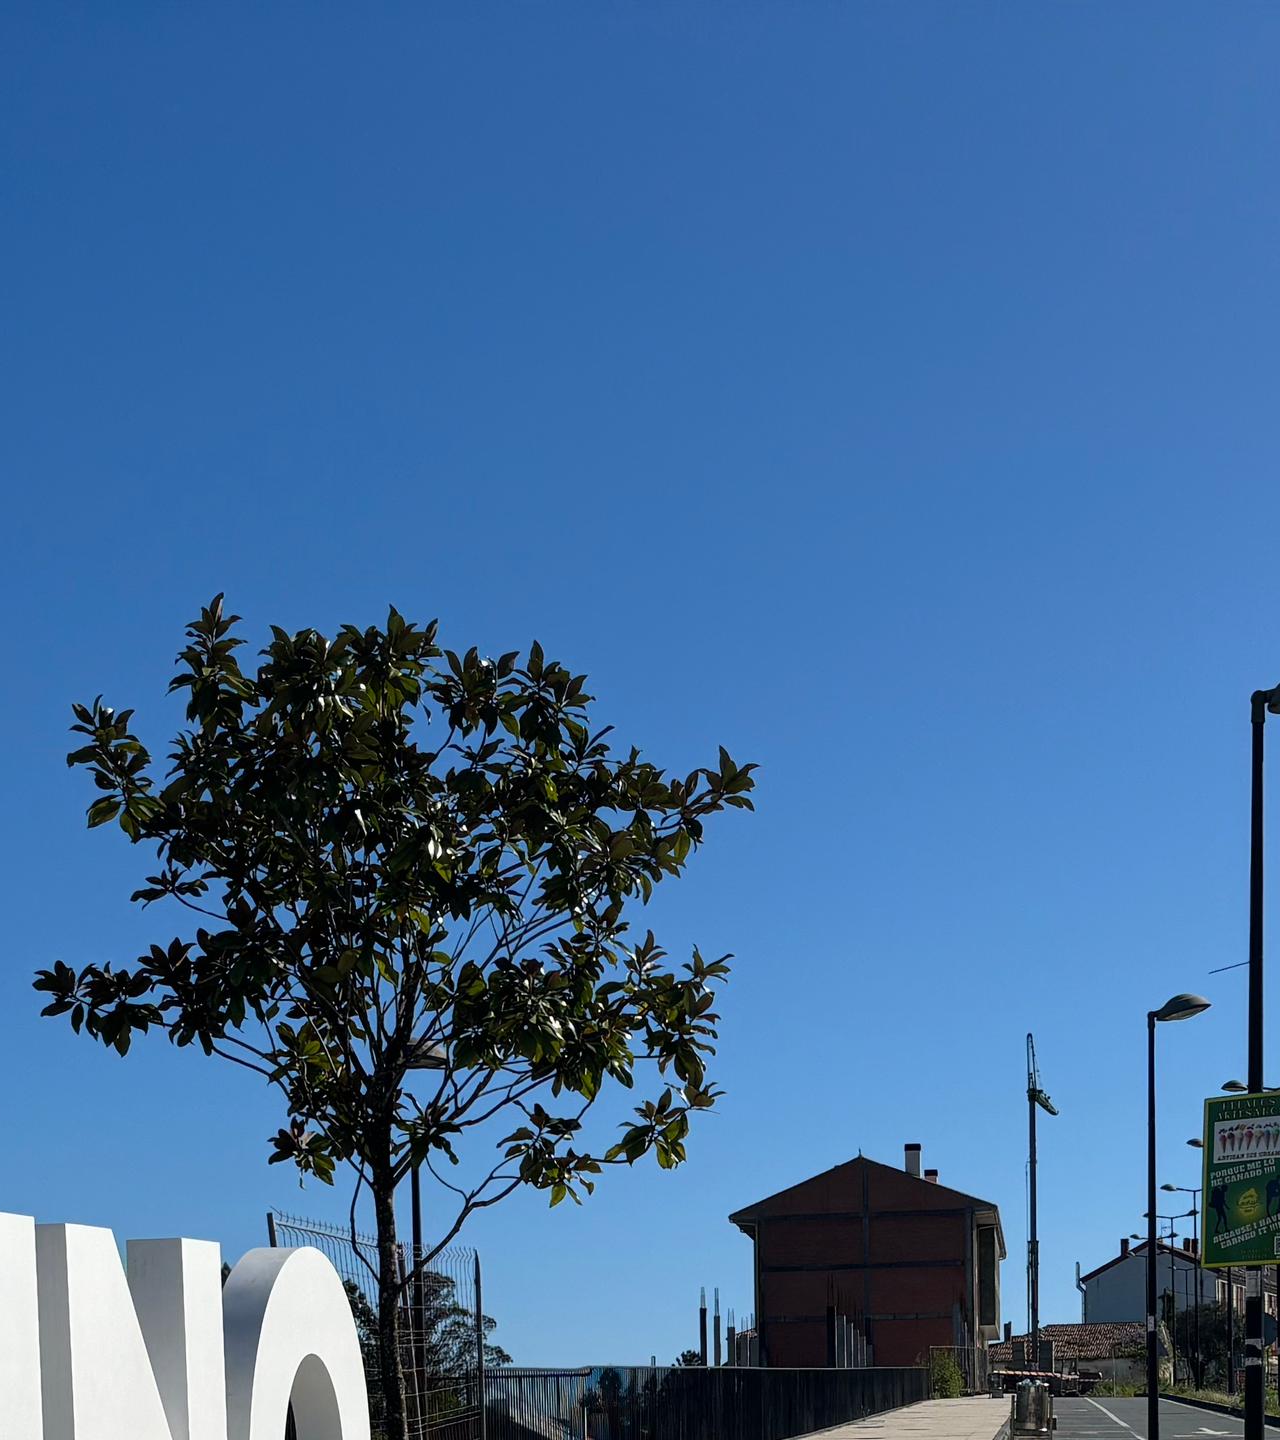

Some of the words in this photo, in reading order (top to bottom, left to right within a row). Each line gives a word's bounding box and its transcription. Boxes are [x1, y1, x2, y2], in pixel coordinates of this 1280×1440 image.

[1210, 1165, 1245, 1179] PORQUE
[1247, 1160, 1262, 1169] ME
[1264, 1158, 1275, 1167] LO
[1213, 1224, 1252, 1244] BECAUSE
[1220, 1231, 1256, 1249] EARNED
[1258, 1226, 1268, 1235] IT
